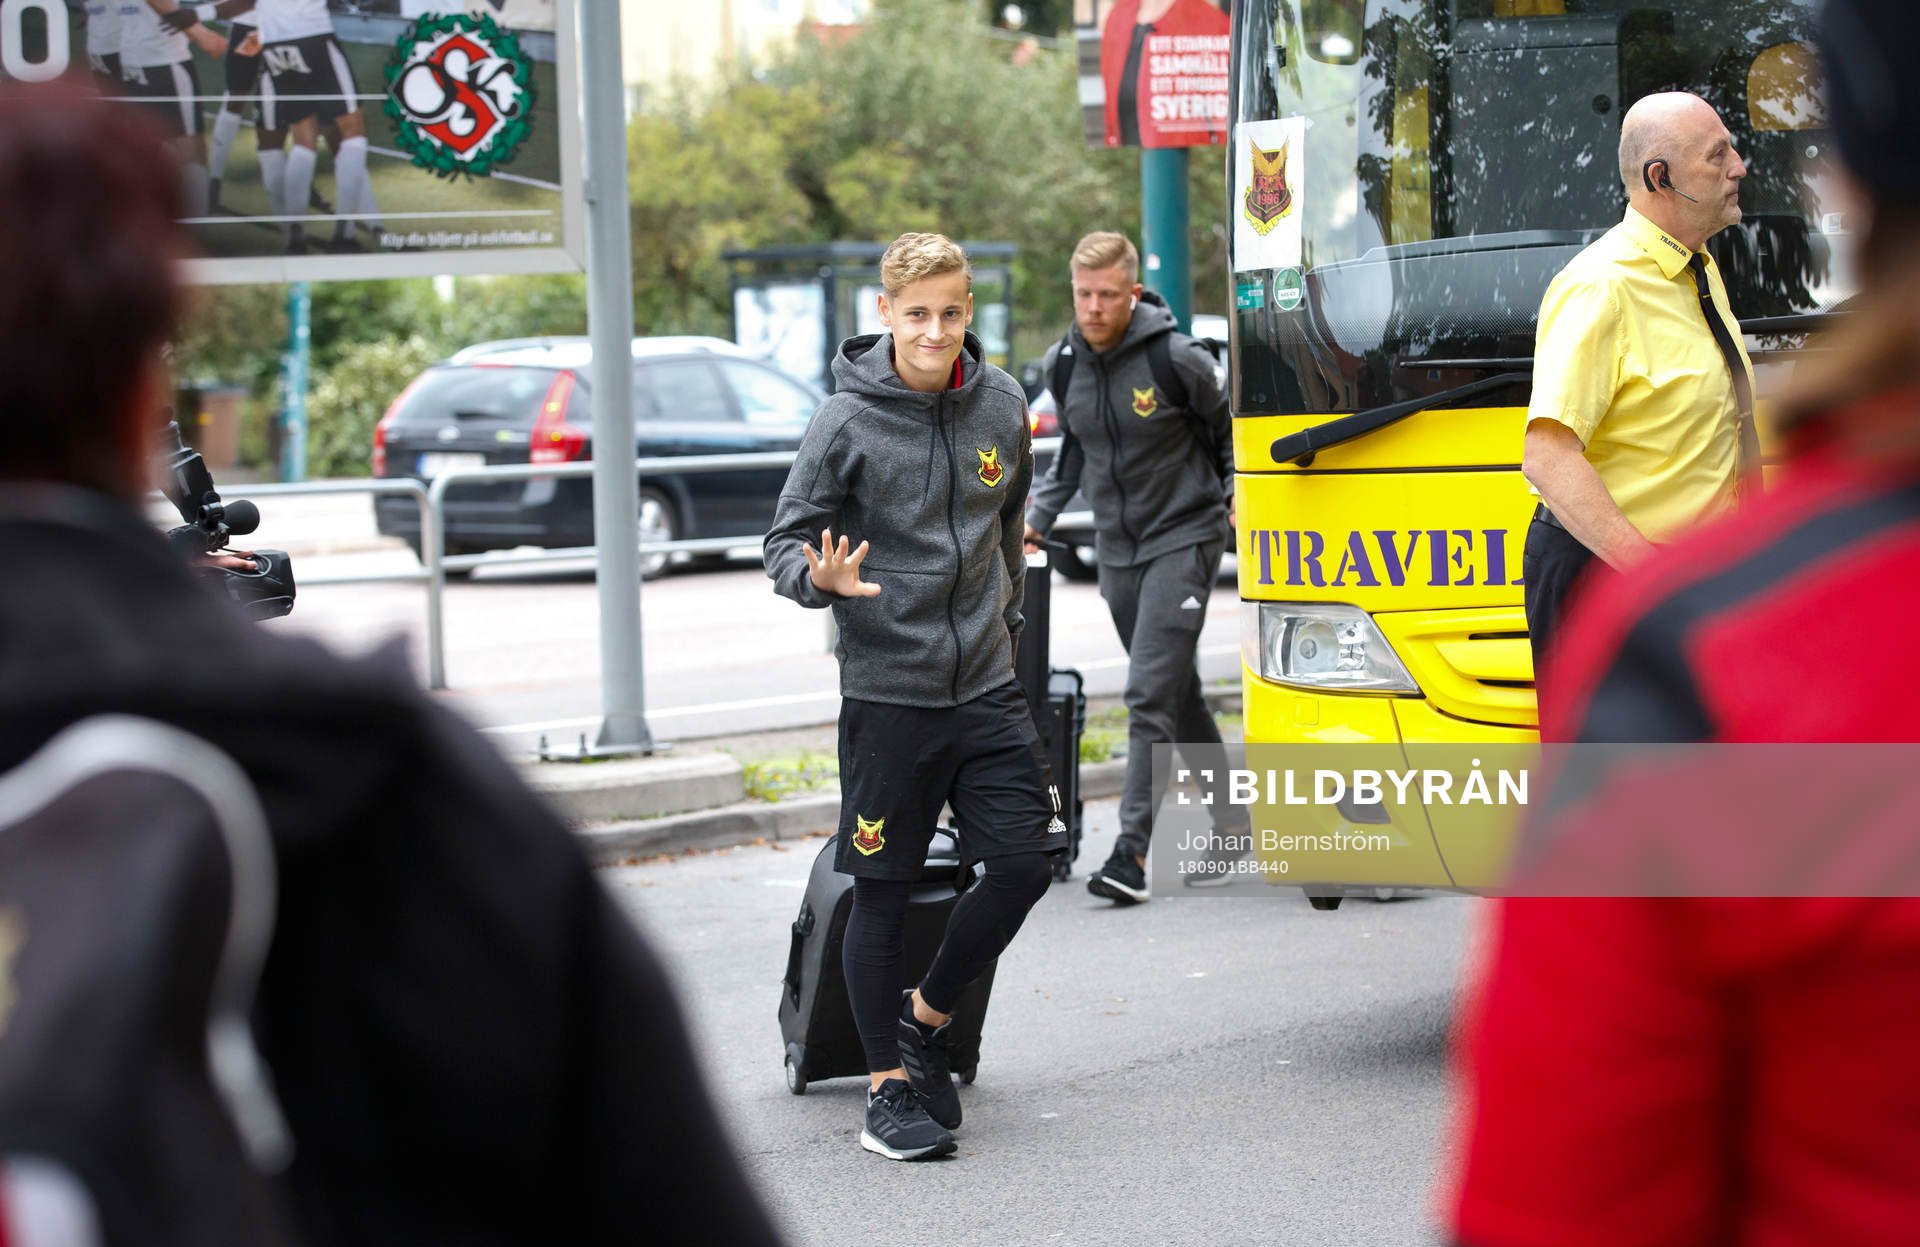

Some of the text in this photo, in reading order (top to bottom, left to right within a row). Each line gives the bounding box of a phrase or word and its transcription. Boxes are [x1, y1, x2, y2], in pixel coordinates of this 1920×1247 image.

[1151, 94, 1228, 120] SVERIG
[1257, 192, 1279, 205] 1996
[1660, 235, 1687, 258] TRAVELLER
